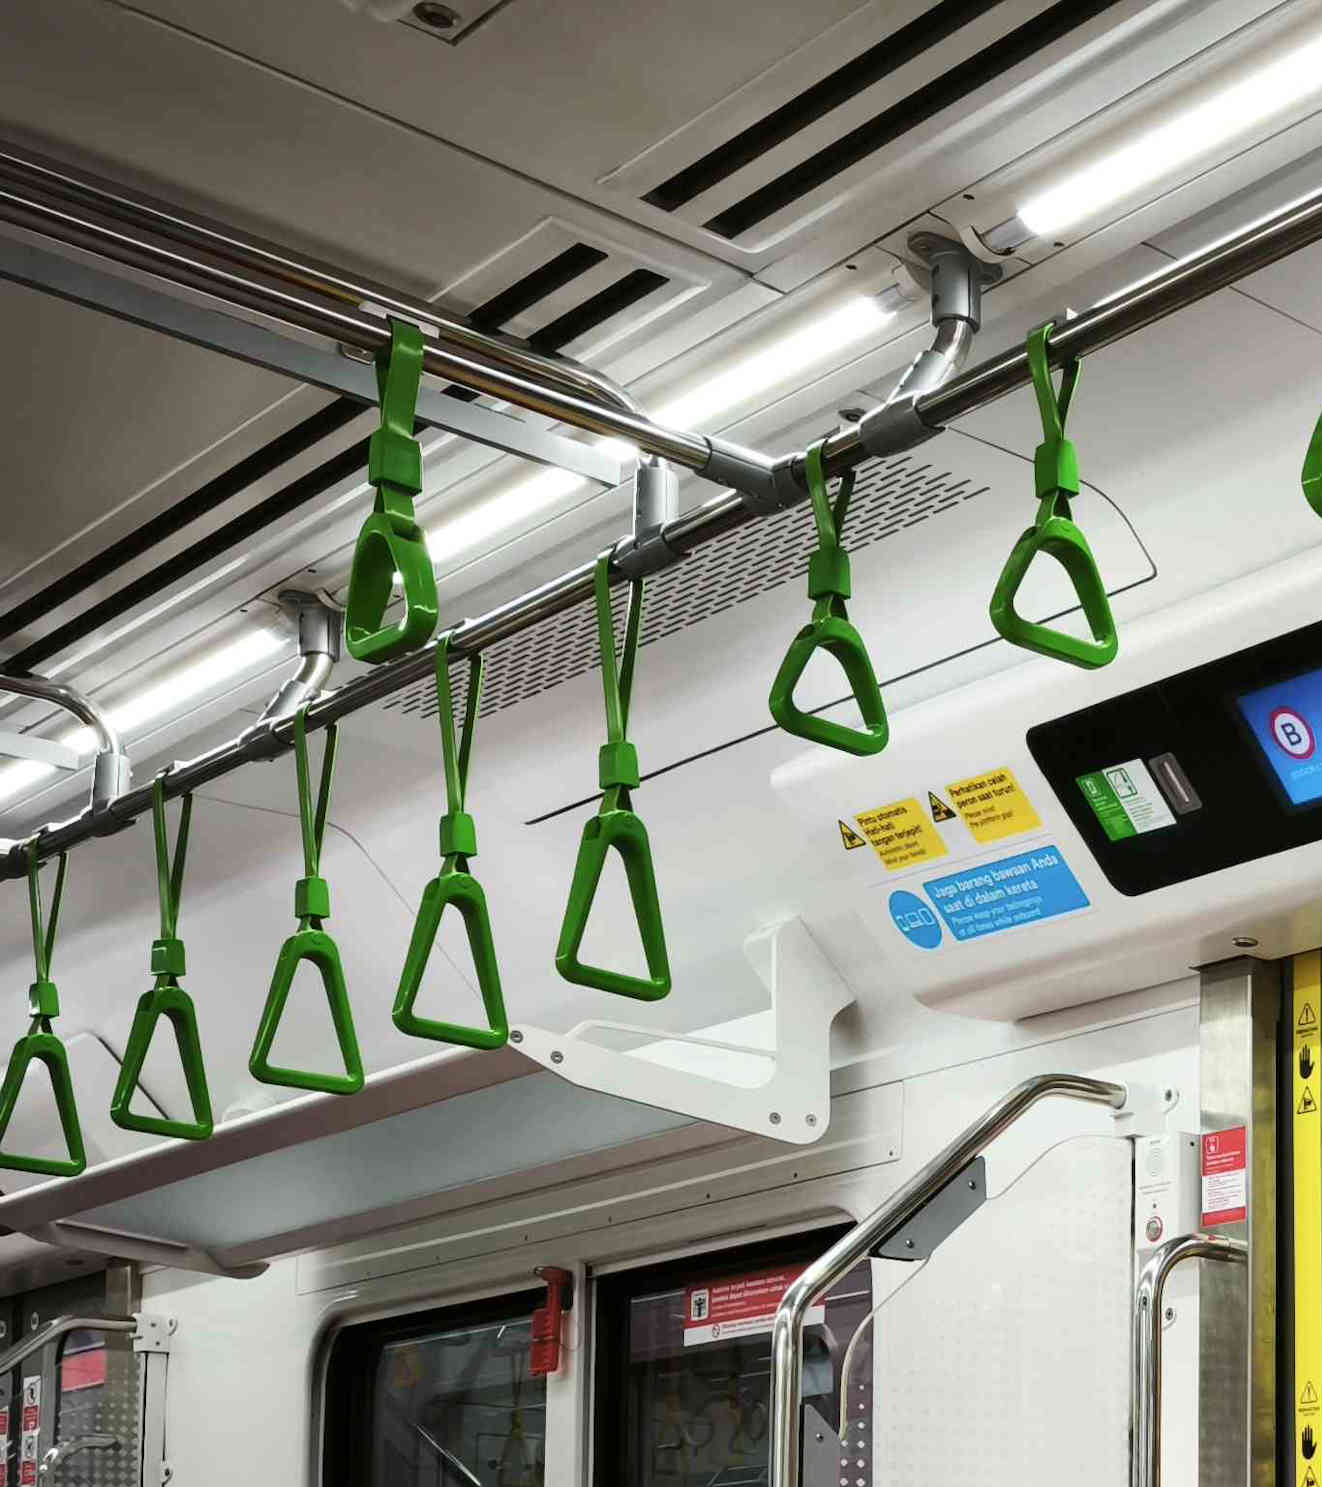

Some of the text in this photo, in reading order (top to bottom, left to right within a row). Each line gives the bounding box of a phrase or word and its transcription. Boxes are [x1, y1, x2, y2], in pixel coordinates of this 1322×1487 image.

[1281, 722, 1302, 746] B
[934, 853, 1059, 899] Jaga barang bawaan Anda
[943, 879, 1039, 914] saat di dalam kereta
